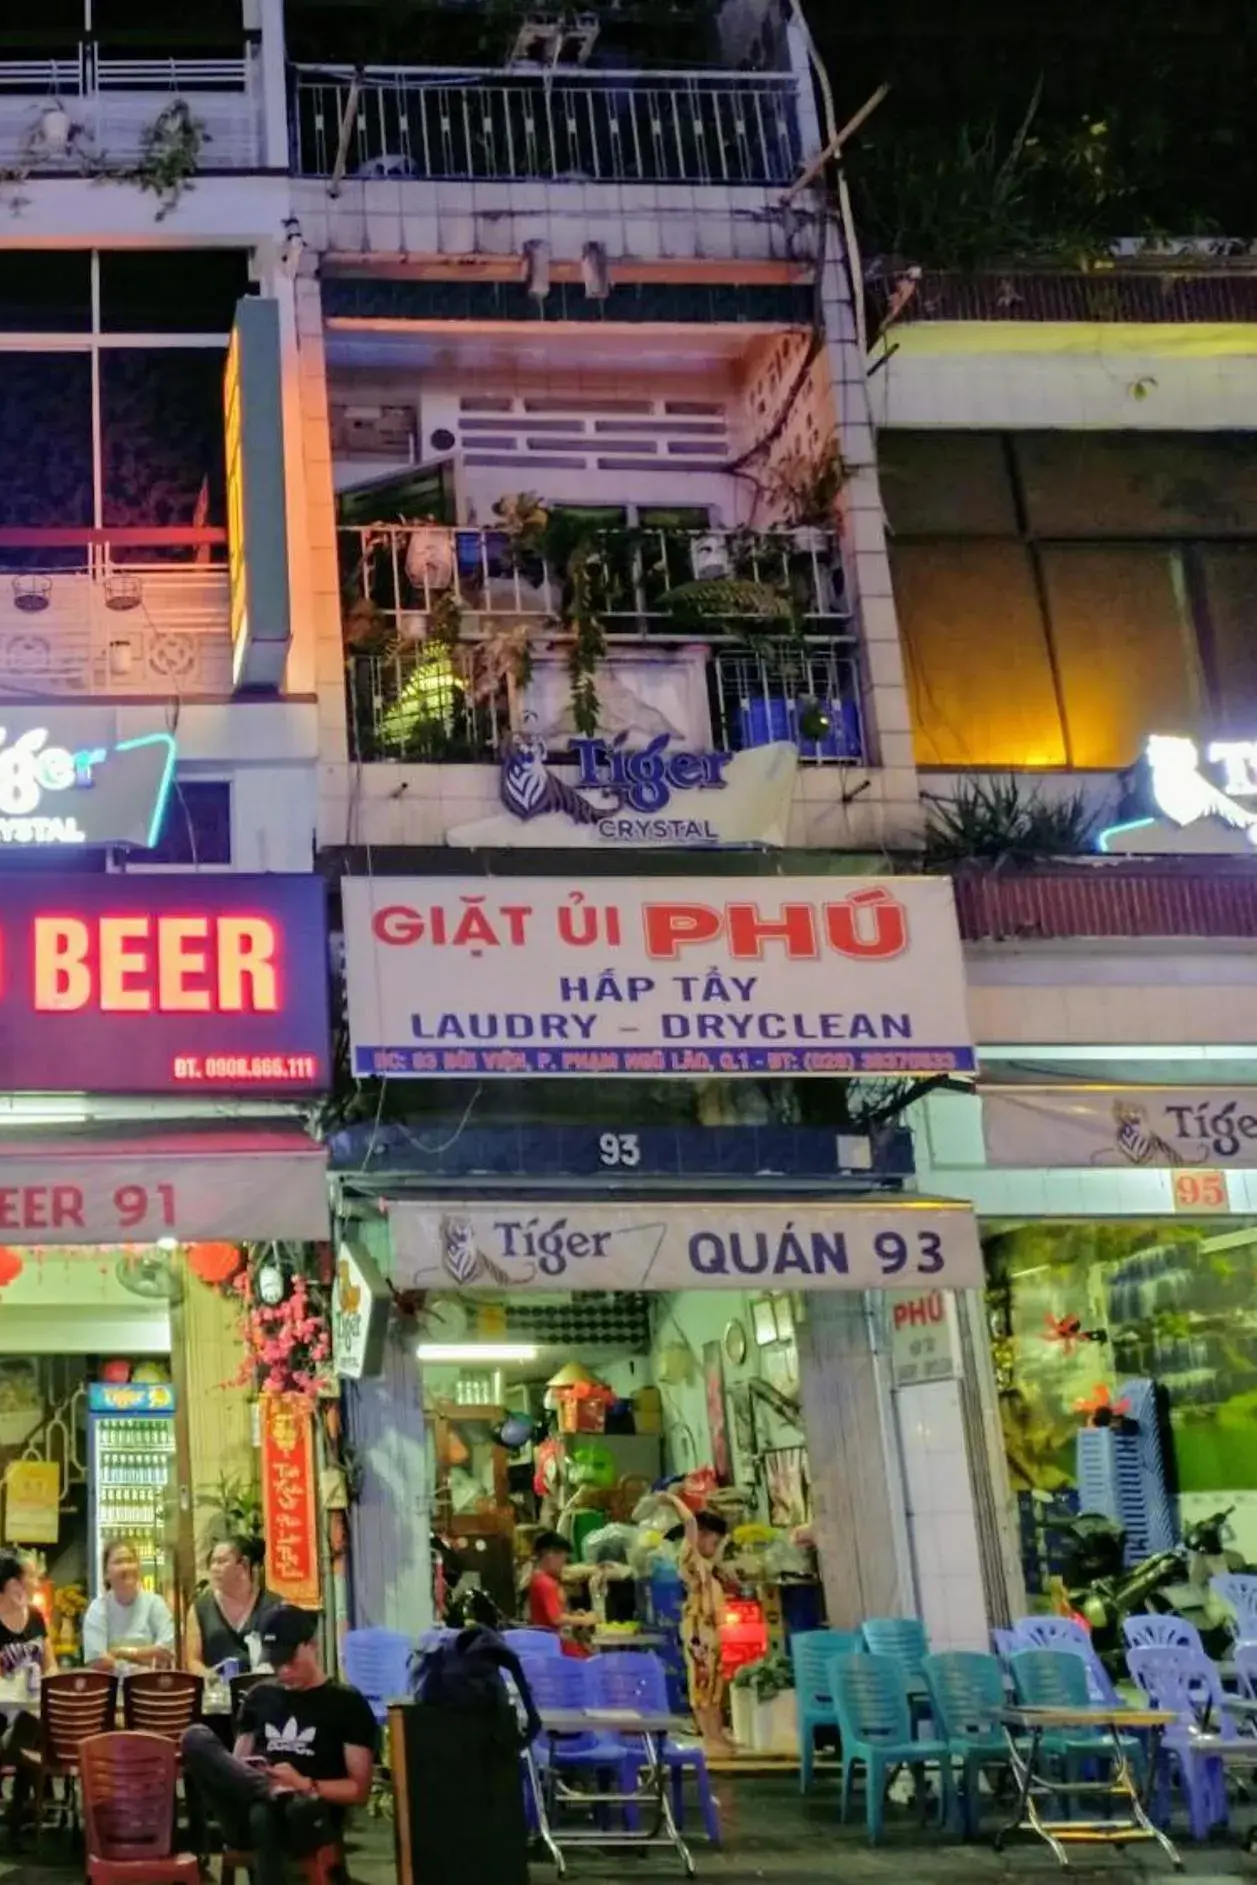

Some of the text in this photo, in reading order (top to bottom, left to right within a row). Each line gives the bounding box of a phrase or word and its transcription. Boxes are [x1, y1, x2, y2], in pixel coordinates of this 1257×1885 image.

[568, 732, 735, 813] Tiger
[598, 818, 720, 840] CRYSTAL
[371, 886, 909, 961] GIẶT ỦI PHÚ
[33, 915, 281, 1014] BEER
[559, 966, 656, 1002] HẤP
[411, 1013, 598, 1040] LAUDRY
[661, 1012, 912, 1040] DRYCLEAN
[599, 1133, 642, 1166] 93
[1165, 1101, 1257, 1157] Tige
[113, 1184, 178, 1228] 91
[1176, 1175, 1226, 1206] 95
[493, 1217, 613, 1276] Tiger
[687, 1222, 946, 1276] QUÁN 93
